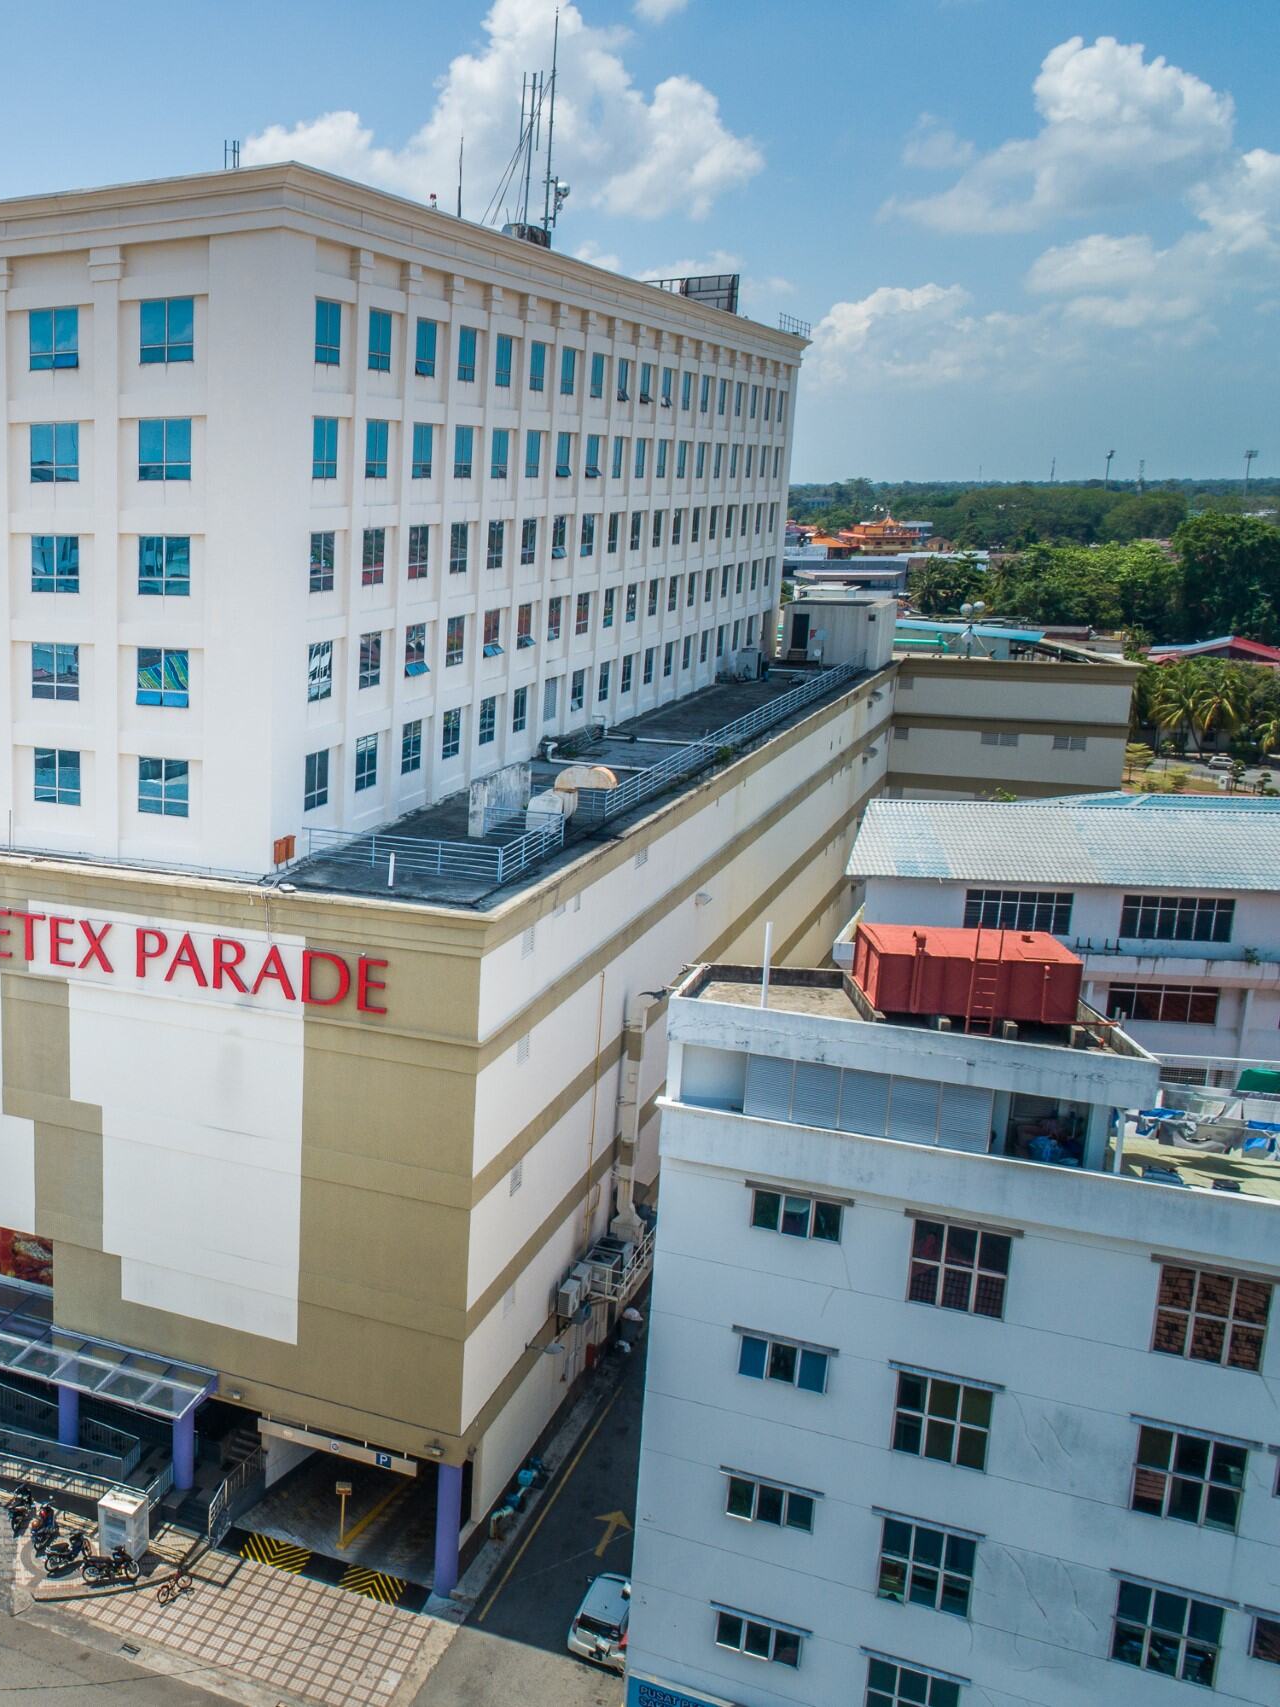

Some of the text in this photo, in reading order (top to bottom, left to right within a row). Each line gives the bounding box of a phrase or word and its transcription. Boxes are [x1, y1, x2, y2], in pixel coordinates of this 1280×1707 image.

[135, 927, 389, 1014] PARADE
[380, 1454, 388, 1465] P
[639, 1686, 677, 1705] PUSAT
